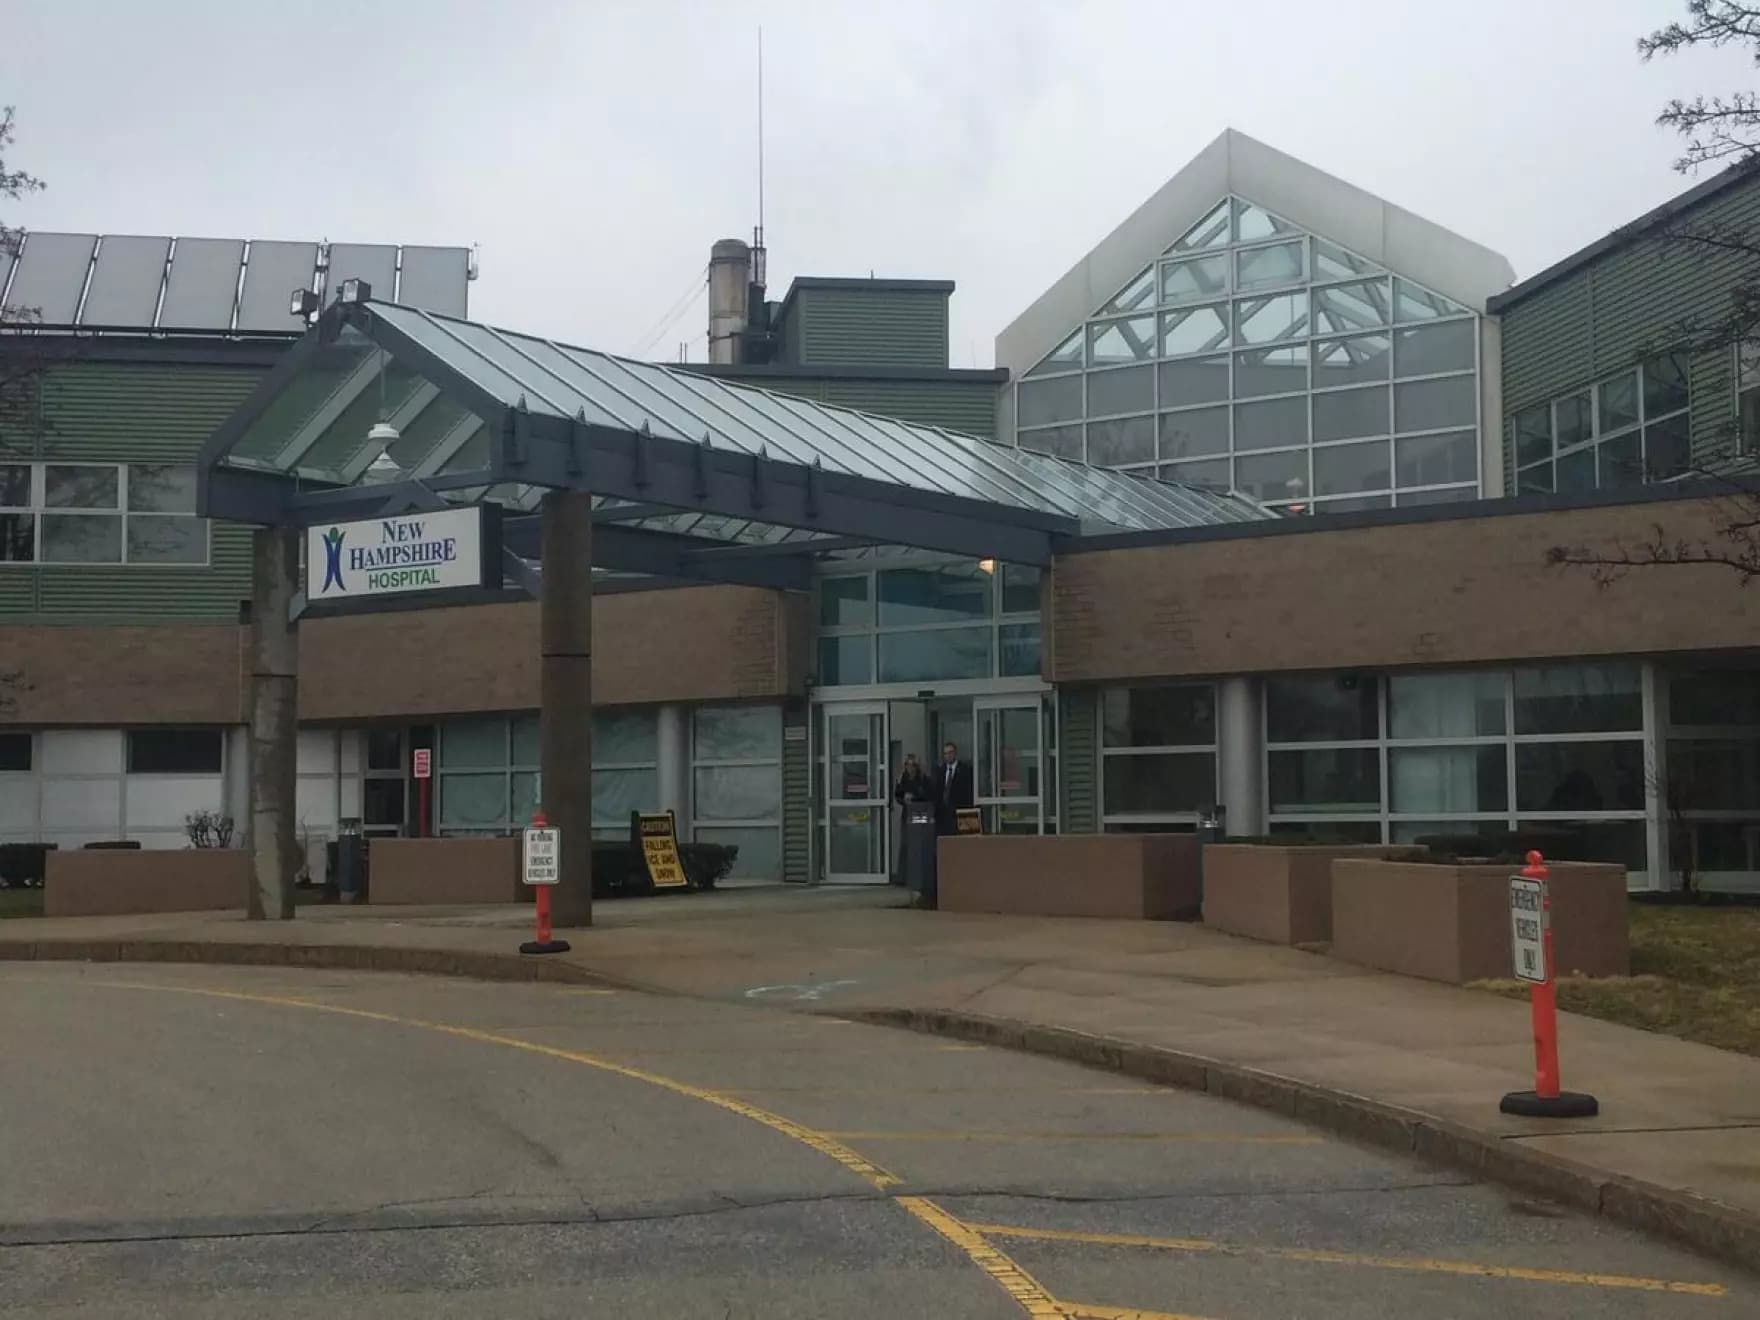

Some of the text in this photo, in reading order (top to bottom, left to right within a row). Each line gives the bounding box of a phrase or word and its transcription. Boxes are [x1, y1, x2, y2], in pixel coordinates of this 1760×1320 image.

[350, 538, 457, 569] HAMPSHIRE
[368, 568, 440, 590] HOSPITAL
[645, 840, 672, 850] FALLING
[655, 868, 675, 879] SNOW
